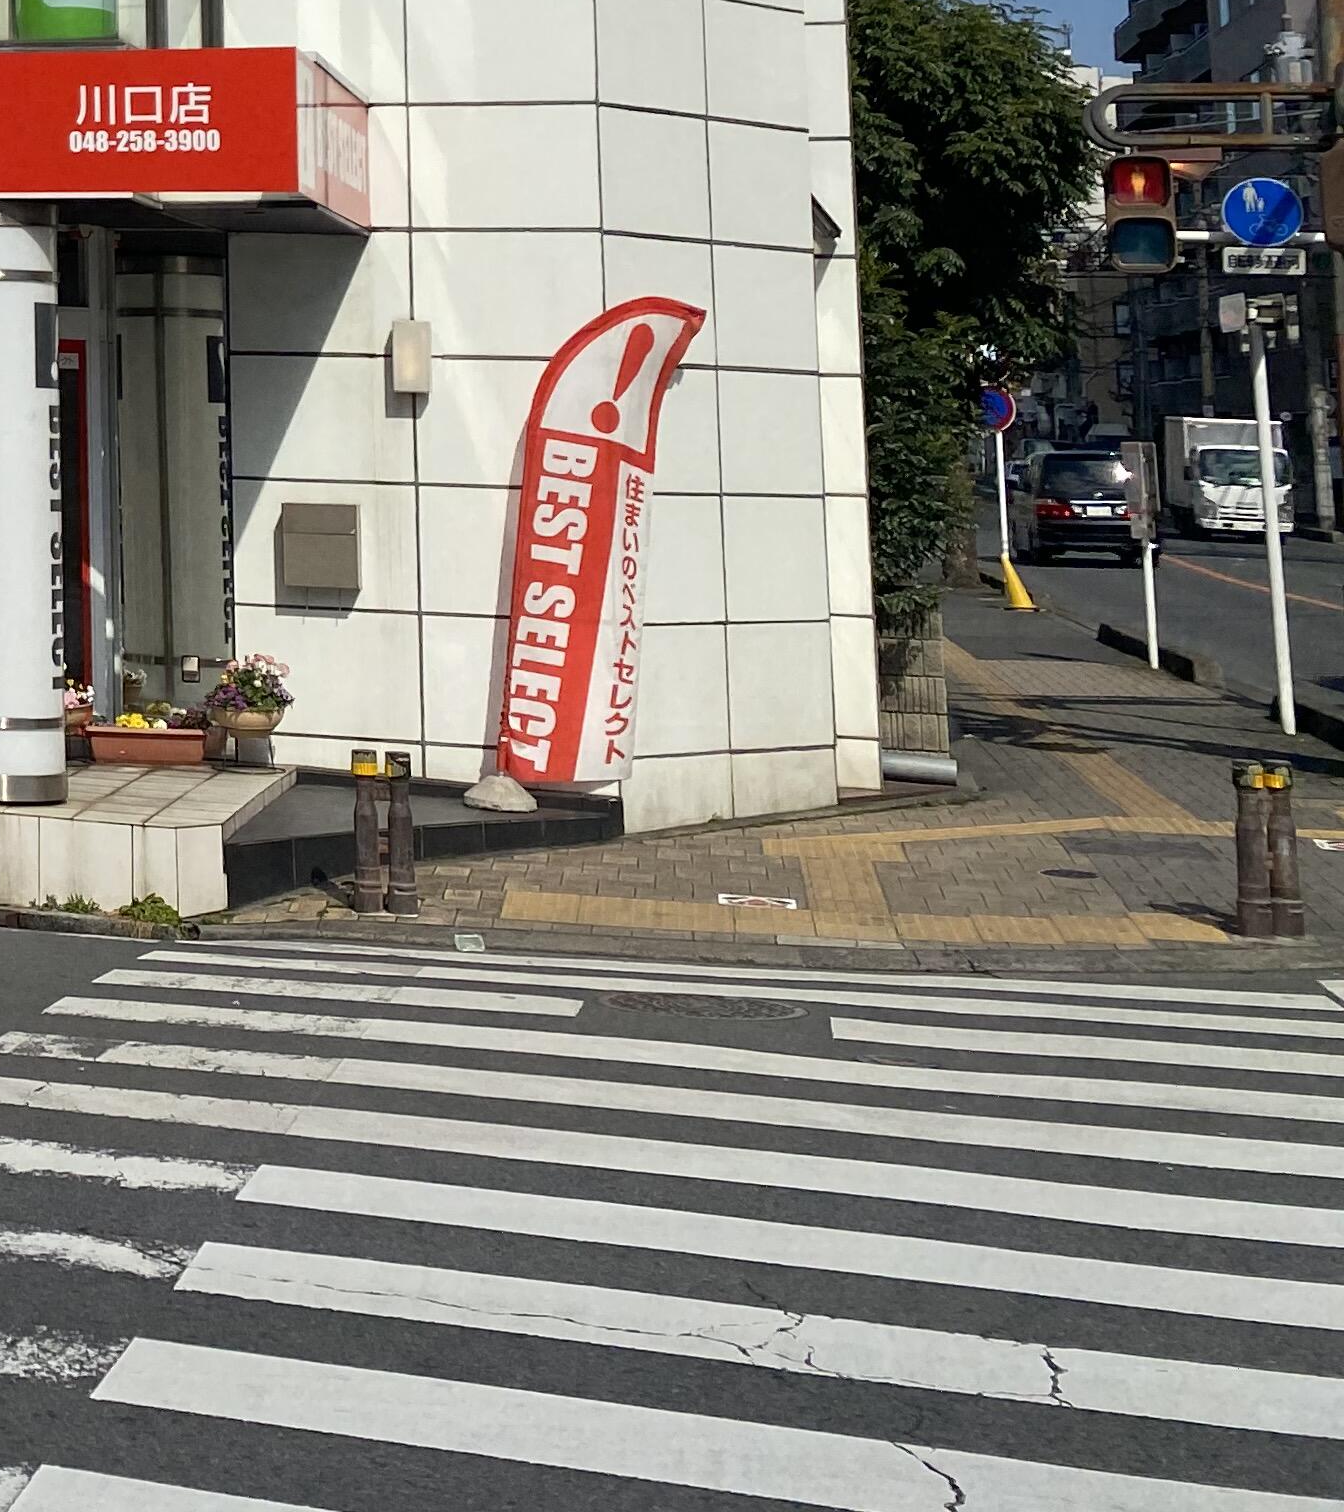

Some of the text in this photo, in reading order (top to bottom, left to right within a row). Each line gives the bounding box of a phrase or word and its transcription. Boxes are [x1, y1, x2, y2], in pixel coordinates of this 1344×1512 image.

[67, 128, 222, 155] 048-258-3900
[75, 82, 213, 127] 川口店
[507, 439, 599, 773] BEST SELECT
[602, 471, 646, 765] 住まいのベストセレクト
